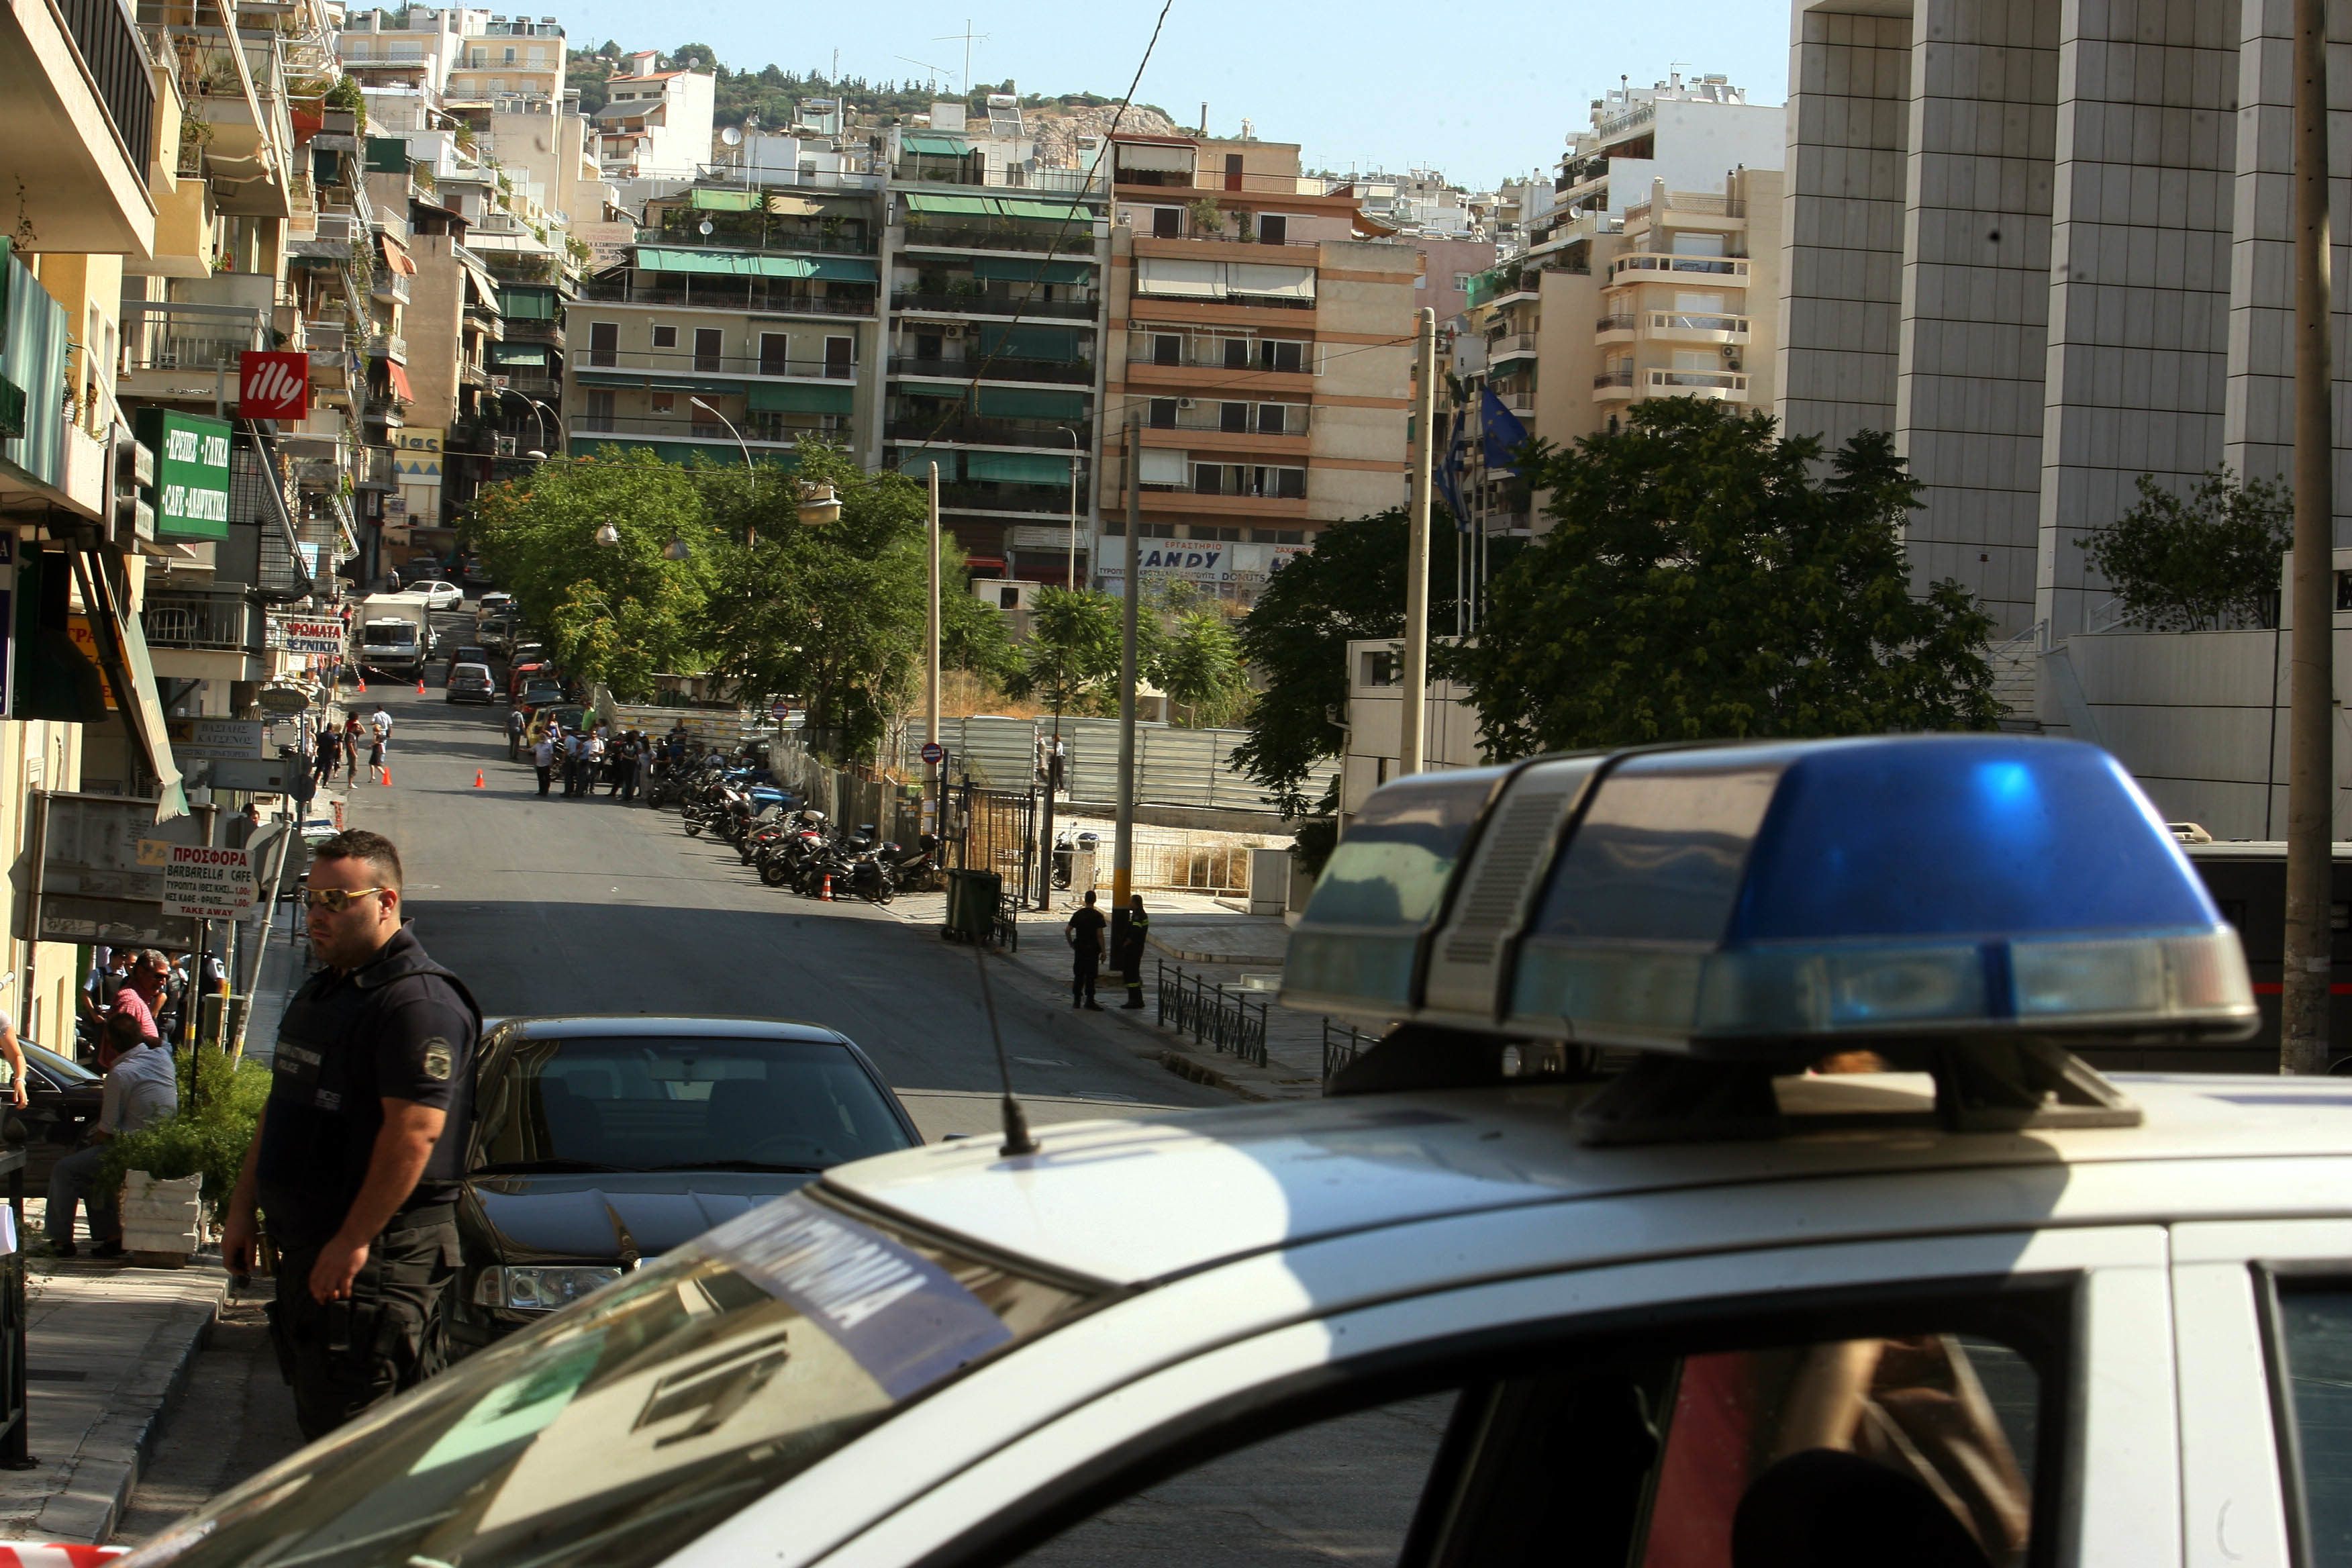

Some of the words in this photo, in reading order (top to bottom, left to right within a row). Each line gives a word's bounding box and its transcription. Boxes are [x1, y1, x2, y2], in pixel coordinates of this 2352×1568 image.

[247, 361, 303, 409] illy
[168, 429, 198, 463] ΚΡΕΠΕΣ
[203, 435, 228, 468] ΓΛΥΚΑ
[164, 484, 185, 517] CAFE
[1165, 541, 1222, 550] ΕΡΓΑΣΤΗΡΙΟ
[1222, 572, 1266, 583] DONUTS
[202, 724, 252, 734] ΒΑΣΙΛΗΣ
[197, 734, 253, 745] ΚΑΤΣΕΝΟΣ
[173, 847, 248, 867] ΠΡΟΣΦΟΡΑ
[167, 865, 224, 881] BARBARELLA
[231, 870, 252, 883] CAFE
[166, 881, 197, 891] ΤΥΡΟΠΙΤΑ
[164, 893, 177, 901] ΝΕΣ
[178, 893, 196, 903] ΚΑΦΕ
[181, 906, 205, 915] TAKE
[206, 908, 234, 917] AWAY
